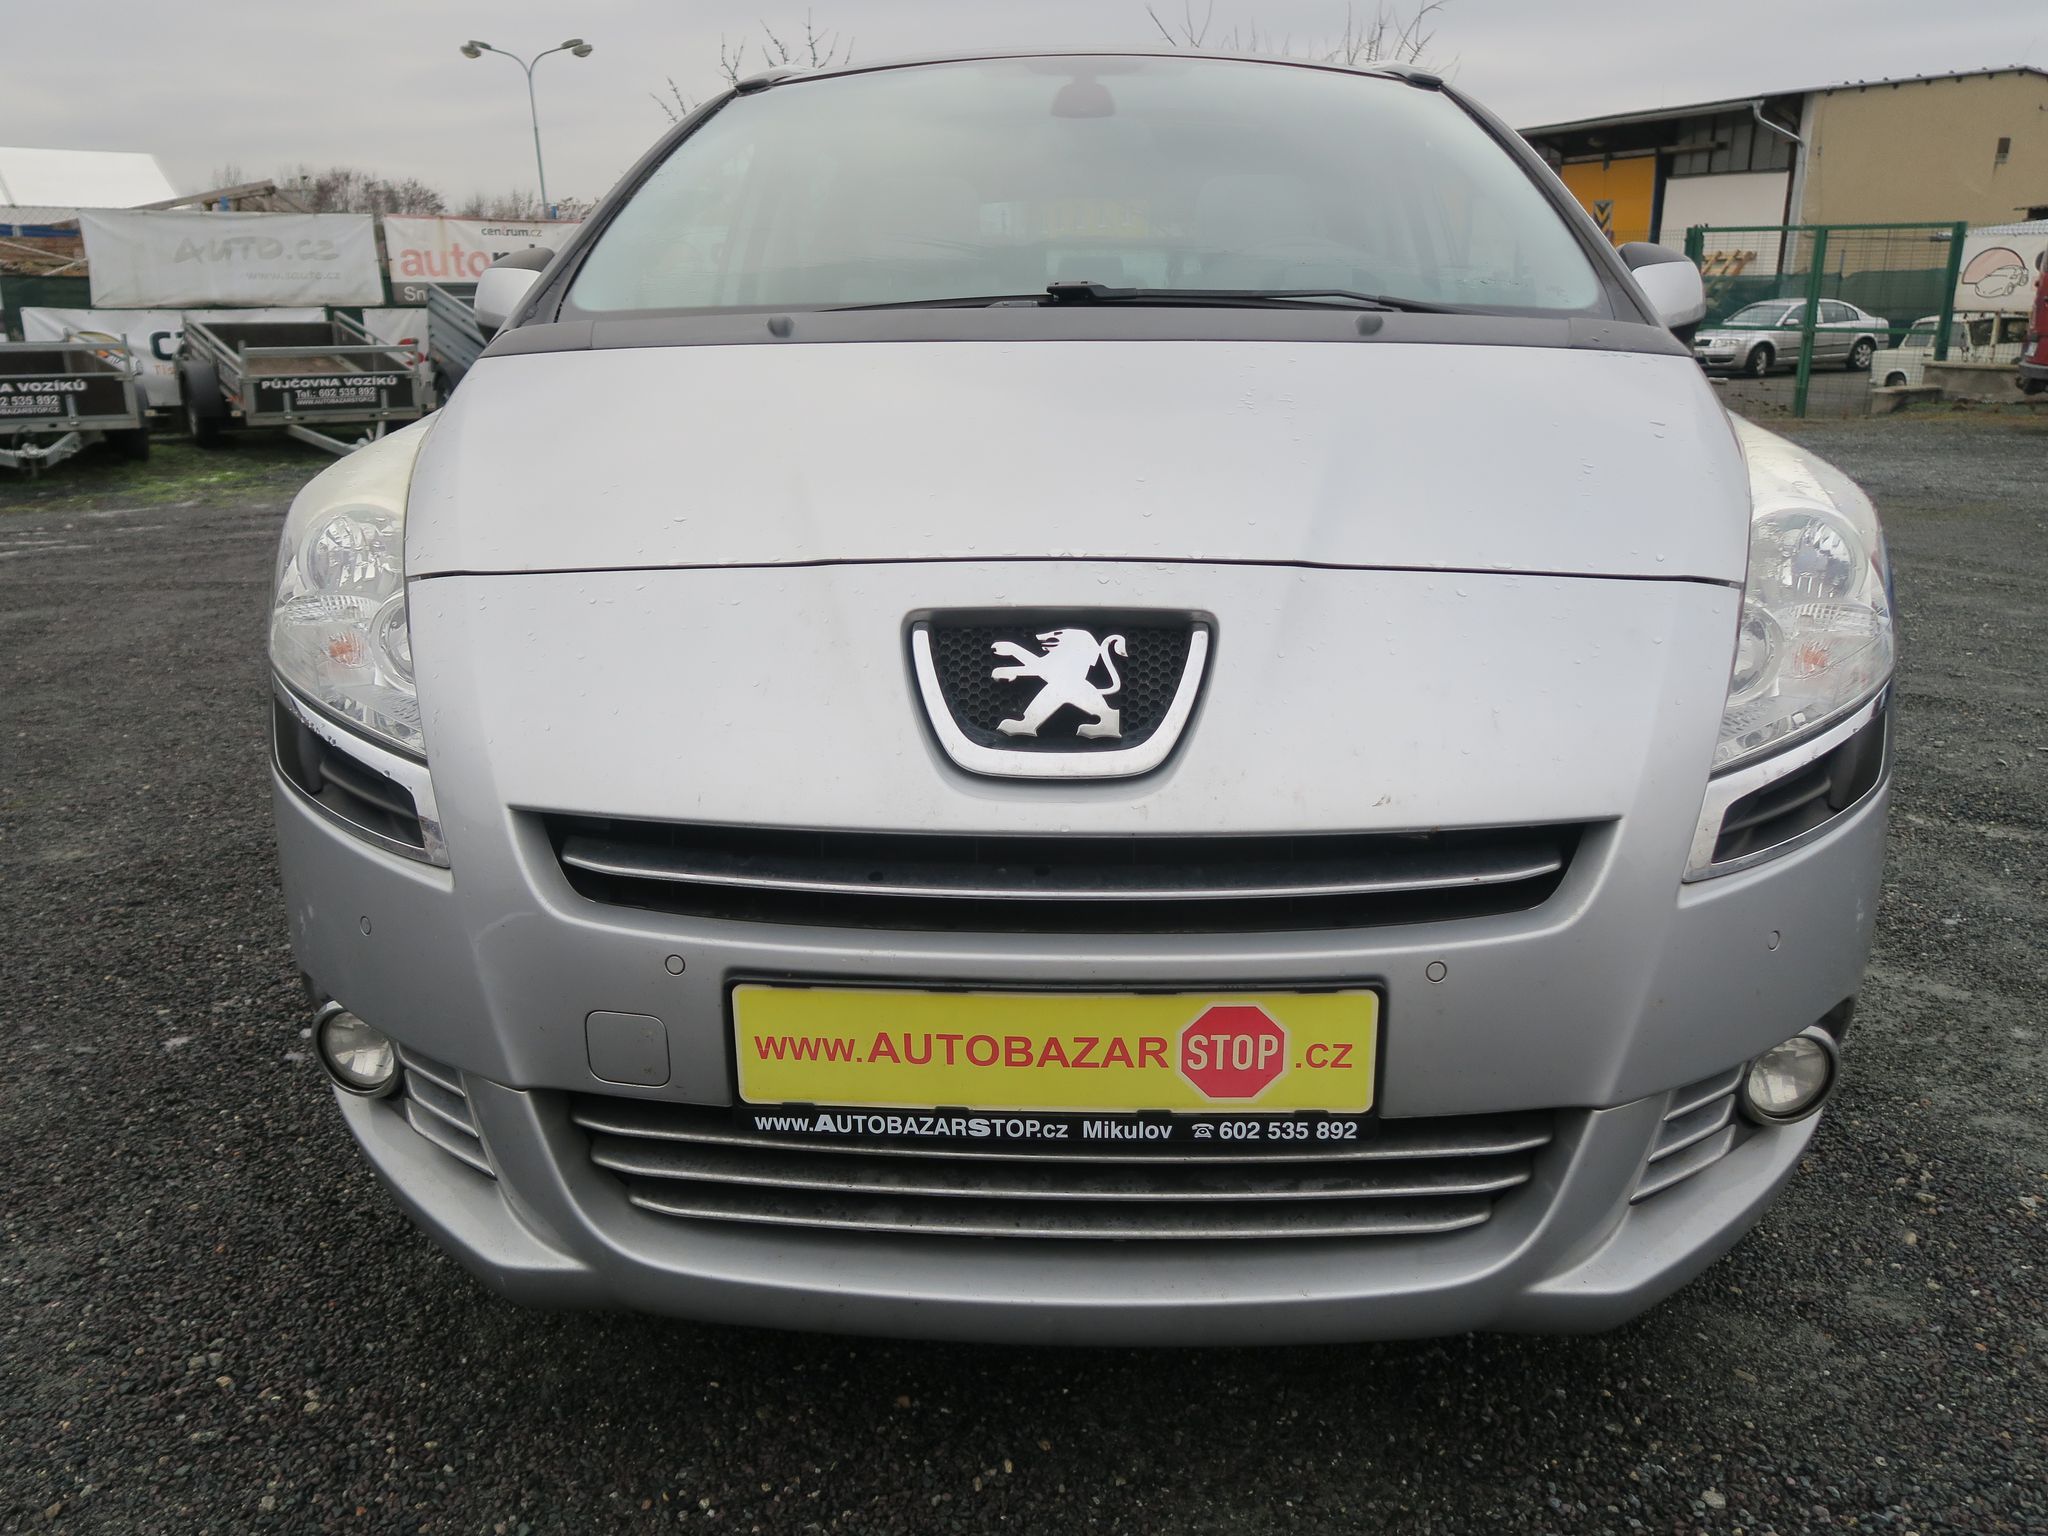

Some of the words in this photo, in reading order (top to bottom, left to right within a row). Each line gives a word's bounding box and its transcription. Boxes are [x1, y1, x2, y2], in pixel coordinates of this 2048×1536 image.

[481, 225, 542, 237] centrum.cz
[318, 388, 337, 398] 602
[339, 387, 355, 397] 535
[358, 386, 376, 396] 892
[11, 394, 33, 406] 535
[36, 394, 60, 406] 892
[1187, 1034, 1279, 1071] STOP
[754, 1114, 1069, 1138] www.AUTOBAZARSTOP.cz
[1083, 1120, 1172, 1139] Mikulov
[1219, 1121, 1260, 1139] 602
[1268, 1122, 1309, 1140] 535
[1316, 1122, 1358, 1140] 892
